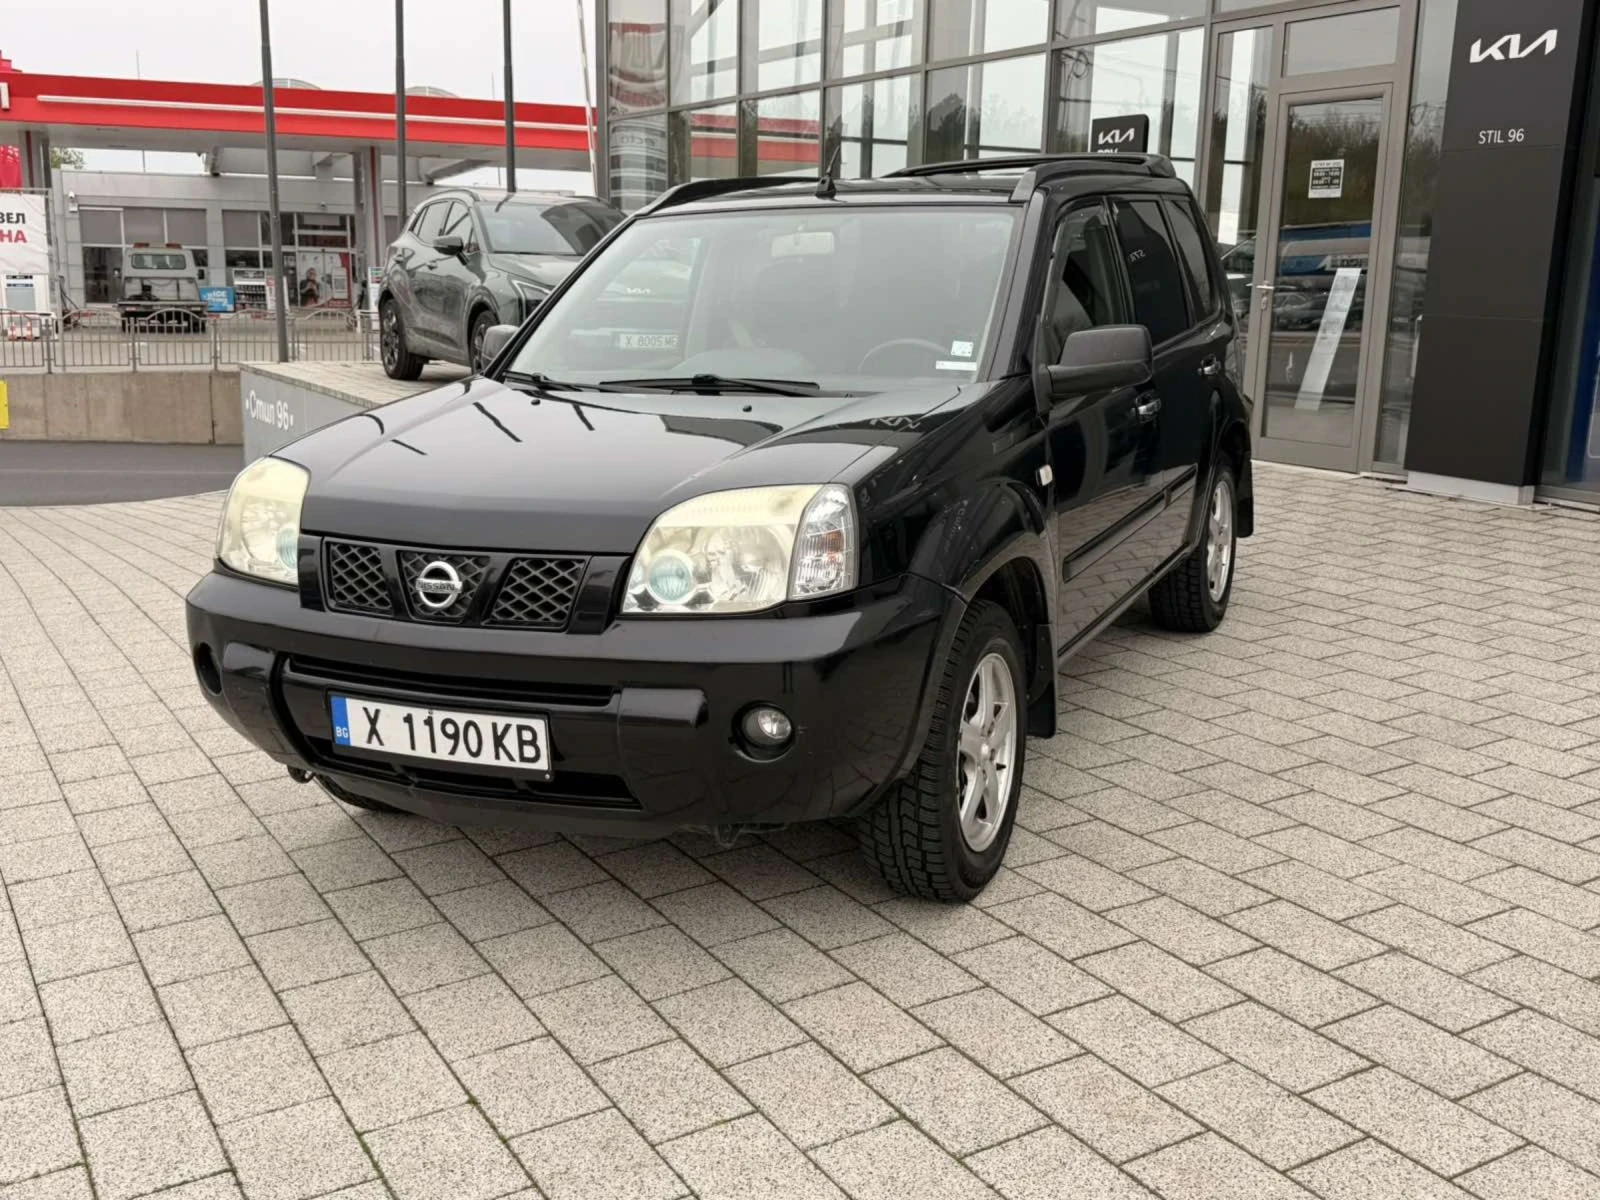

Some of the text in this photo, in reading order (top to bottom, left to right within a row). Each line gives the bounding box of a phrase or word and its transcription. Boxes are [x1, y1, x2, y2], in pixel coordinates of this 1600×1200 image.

[1470, 29, 1557, 63] KIA
[1098, 128, 1135, 144] KIA
[1478, 128, 1525, 144] STIL 96
[276, 400, 290, 430] 96
[336, 726, 349, 738] BG
[362, 706, 541, 764] X 1190 KB
